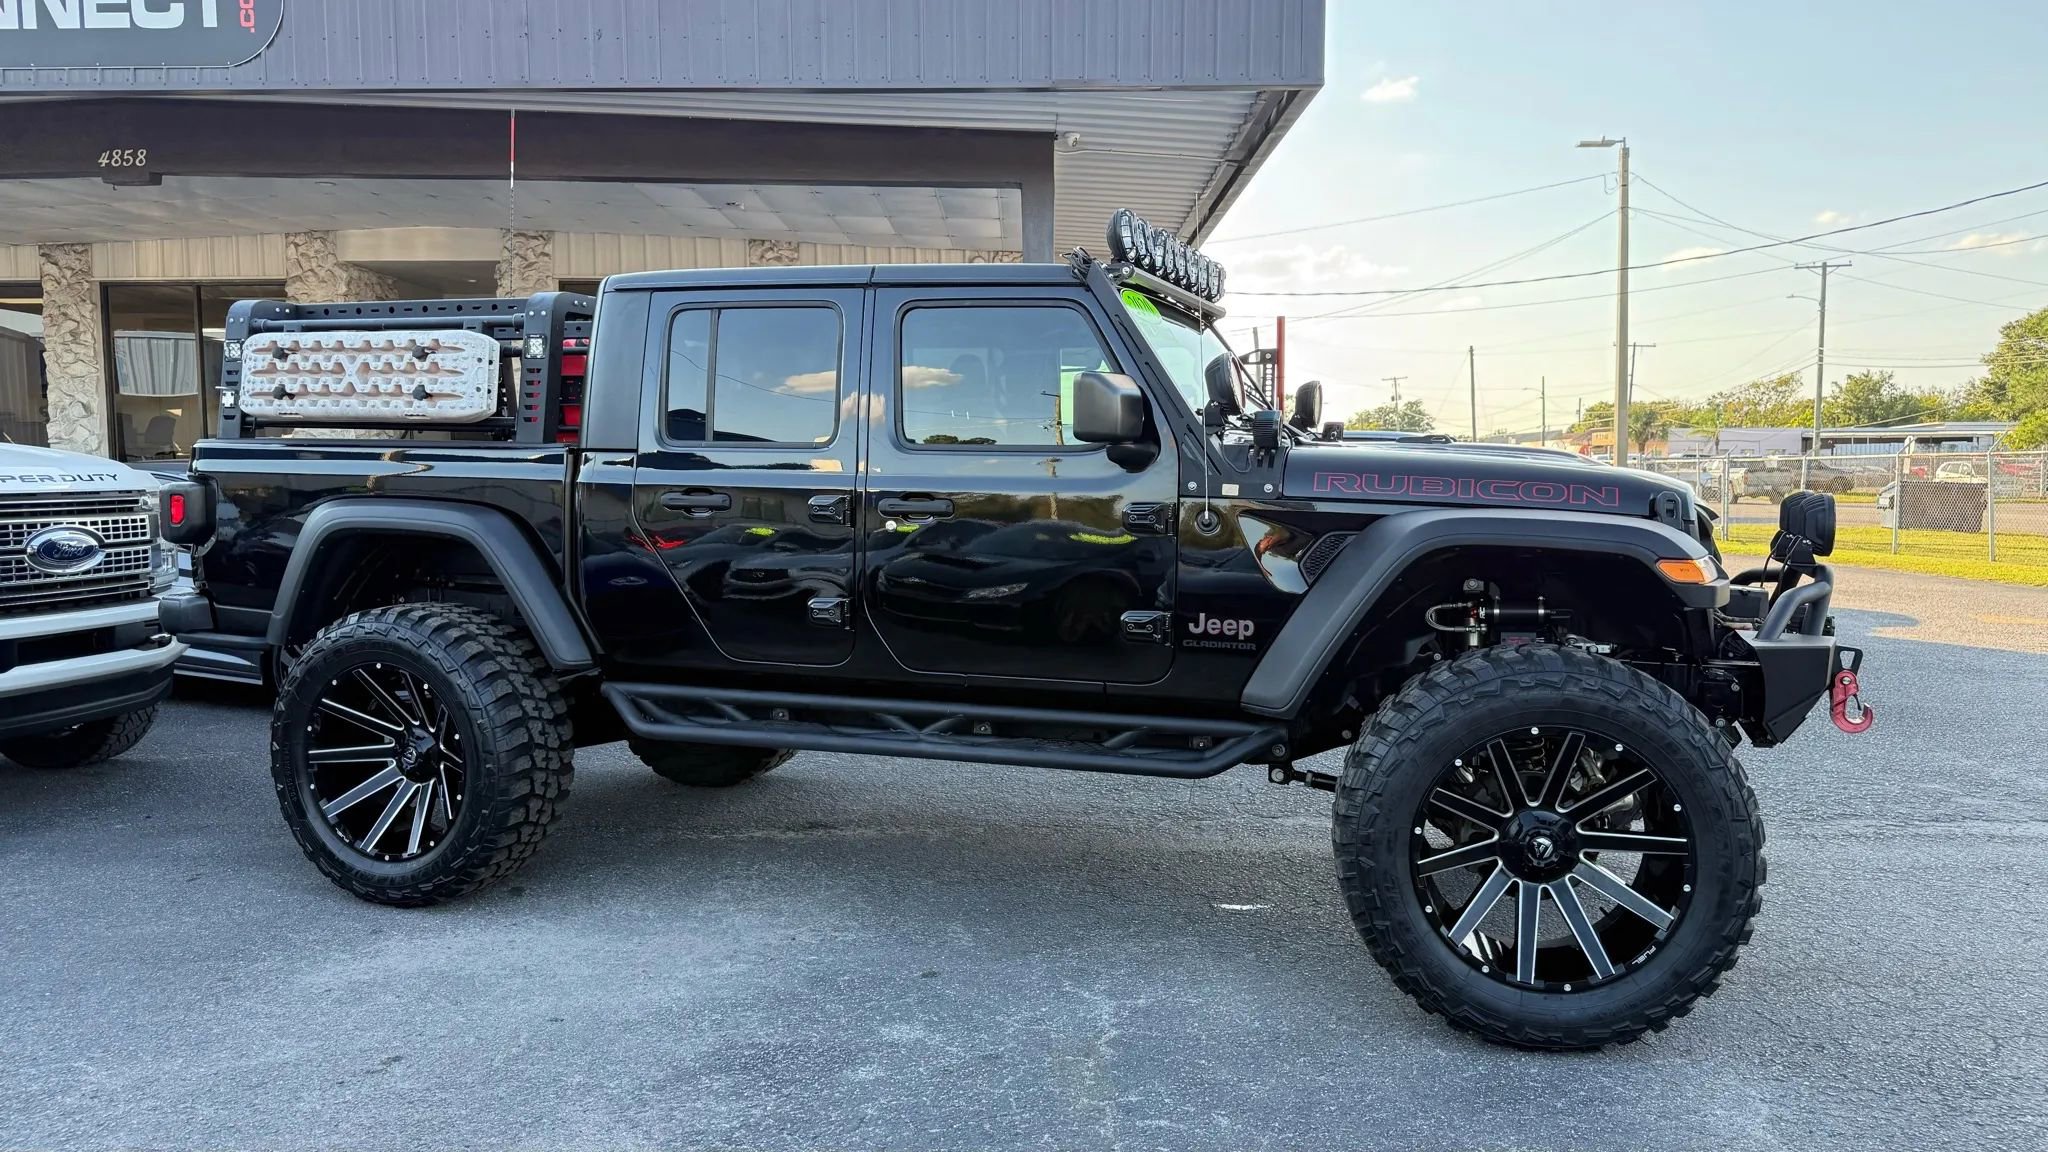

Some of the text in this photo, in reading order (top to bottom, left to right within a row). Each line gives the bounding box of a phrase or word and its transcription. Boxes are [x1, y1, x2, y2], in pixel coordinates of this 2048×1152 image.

[0, 0, 218, 29] NECT
[98, 149, 147, 167] 4858
[59, 473, 118, 482] DUTY
[1313, 472, 1620, 507] RUBICON
[53, 541, 87, 558] Ford
[1188, 612, 1255, 640] Jeep
[1182, 639, 1257, 650] GLADIATOR
[1632, 945, 1657, 964] FUEL
